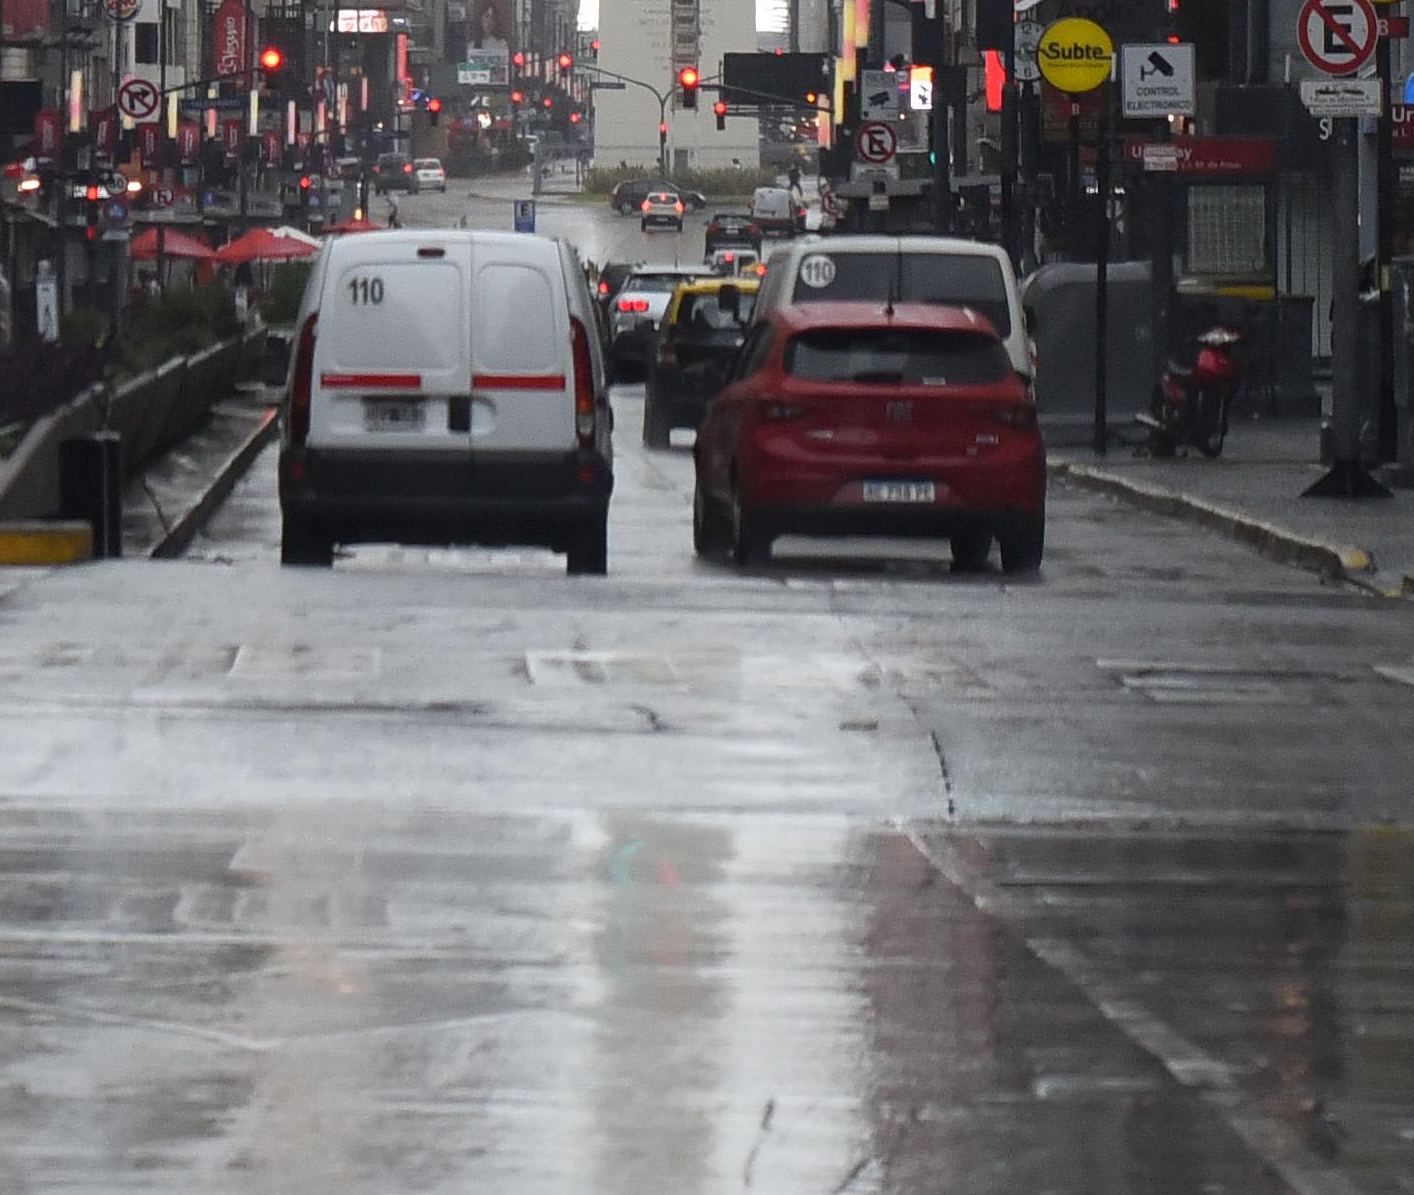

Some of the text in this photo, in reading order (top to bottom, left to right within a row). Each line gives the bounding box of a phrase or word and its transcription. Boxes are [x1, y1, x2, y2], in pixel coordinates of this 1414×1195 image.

[1324, 4, 1352, 55] E
[1046, 41, 1104, 62] Subte
[1136, 86, 1181, 97] CONTROL
[805, 260, 833, 286] 110
[349, 276, 384, 307] 110
